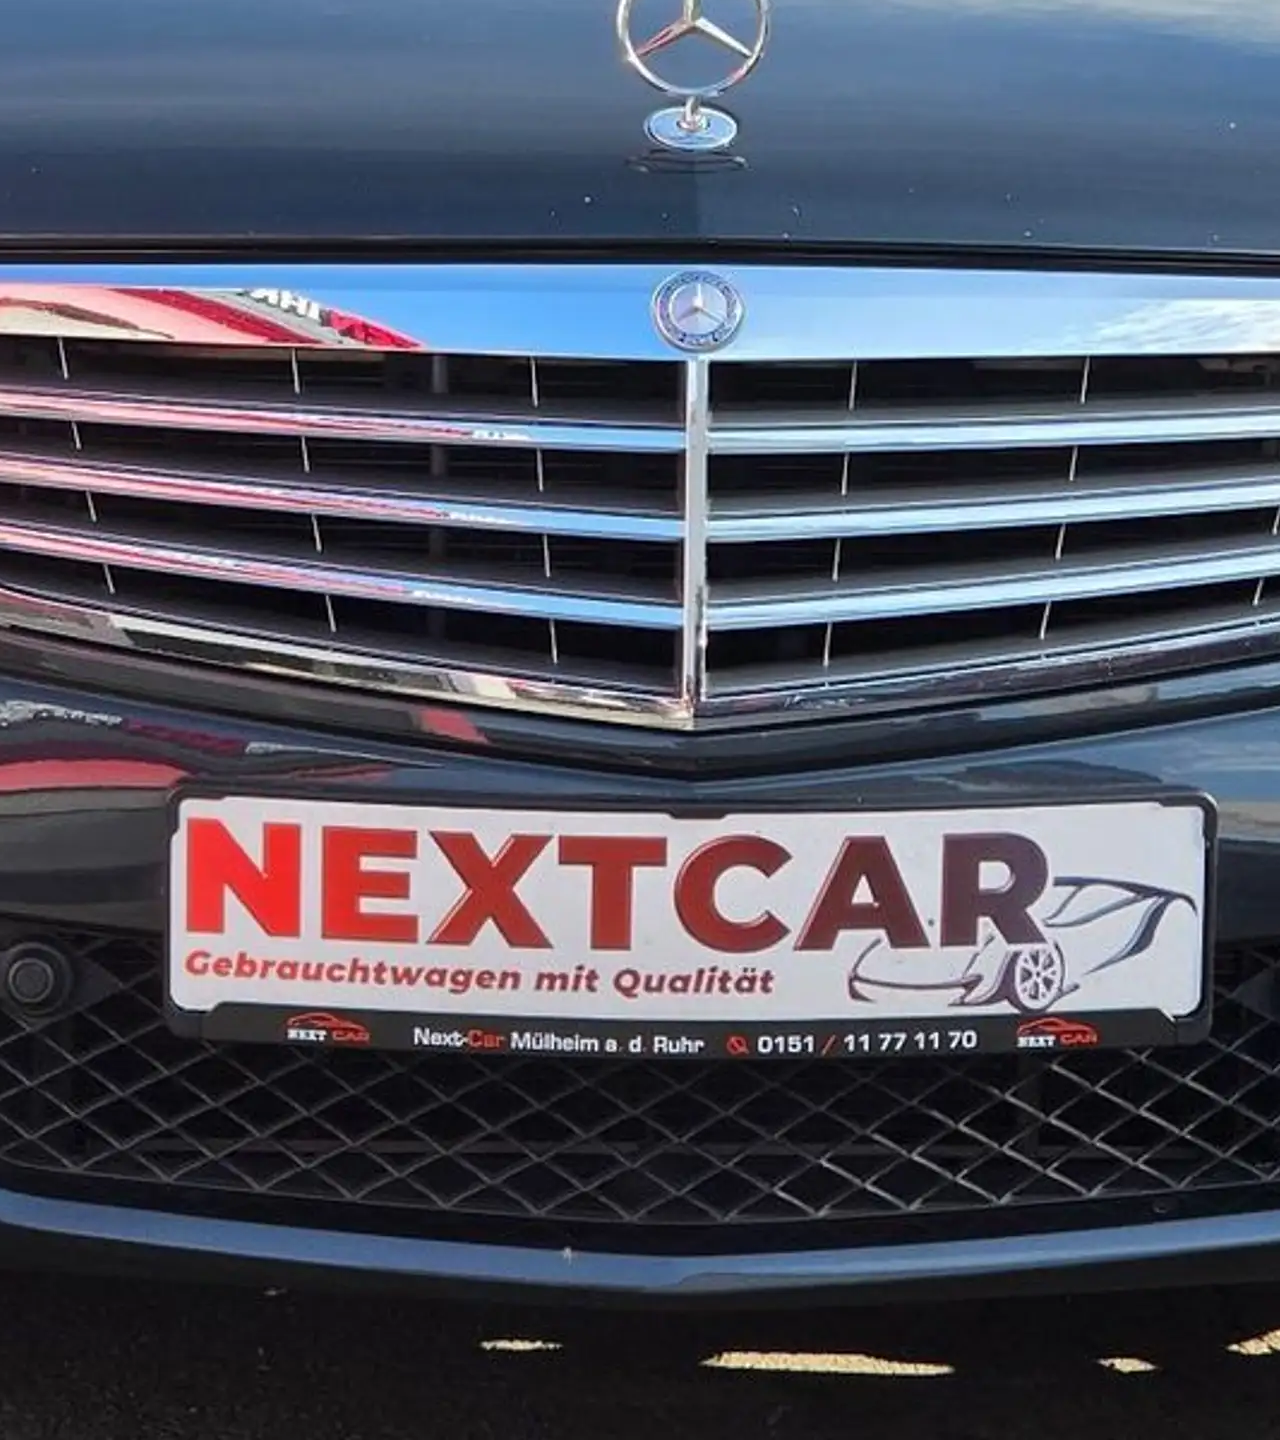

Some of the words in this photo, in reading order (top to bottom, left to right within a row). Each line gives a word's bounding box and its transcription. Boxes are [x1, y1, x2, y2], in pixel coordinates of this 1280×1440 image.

[185, 817, 1050, 955] NEXTCAR
[184, 949, 522, 994] Gebrauchtwagen
[534, 965, 600, 992] mit
[613, 966, 775, 998] Qualität
[413, 1026, 505, 1049] Next-Car
[510, 1031, 599, 1053] Mülheim
[653, 1035, 705, 1053] Ruhr
[757, 1035, 814, 1054] 0151
[843, 1034, 869, 1052] 11
[879, 1032, 908, 1050] 77
[914, 1032, 940, 1050] 11
[948, 1030, 977, 1049] 70
